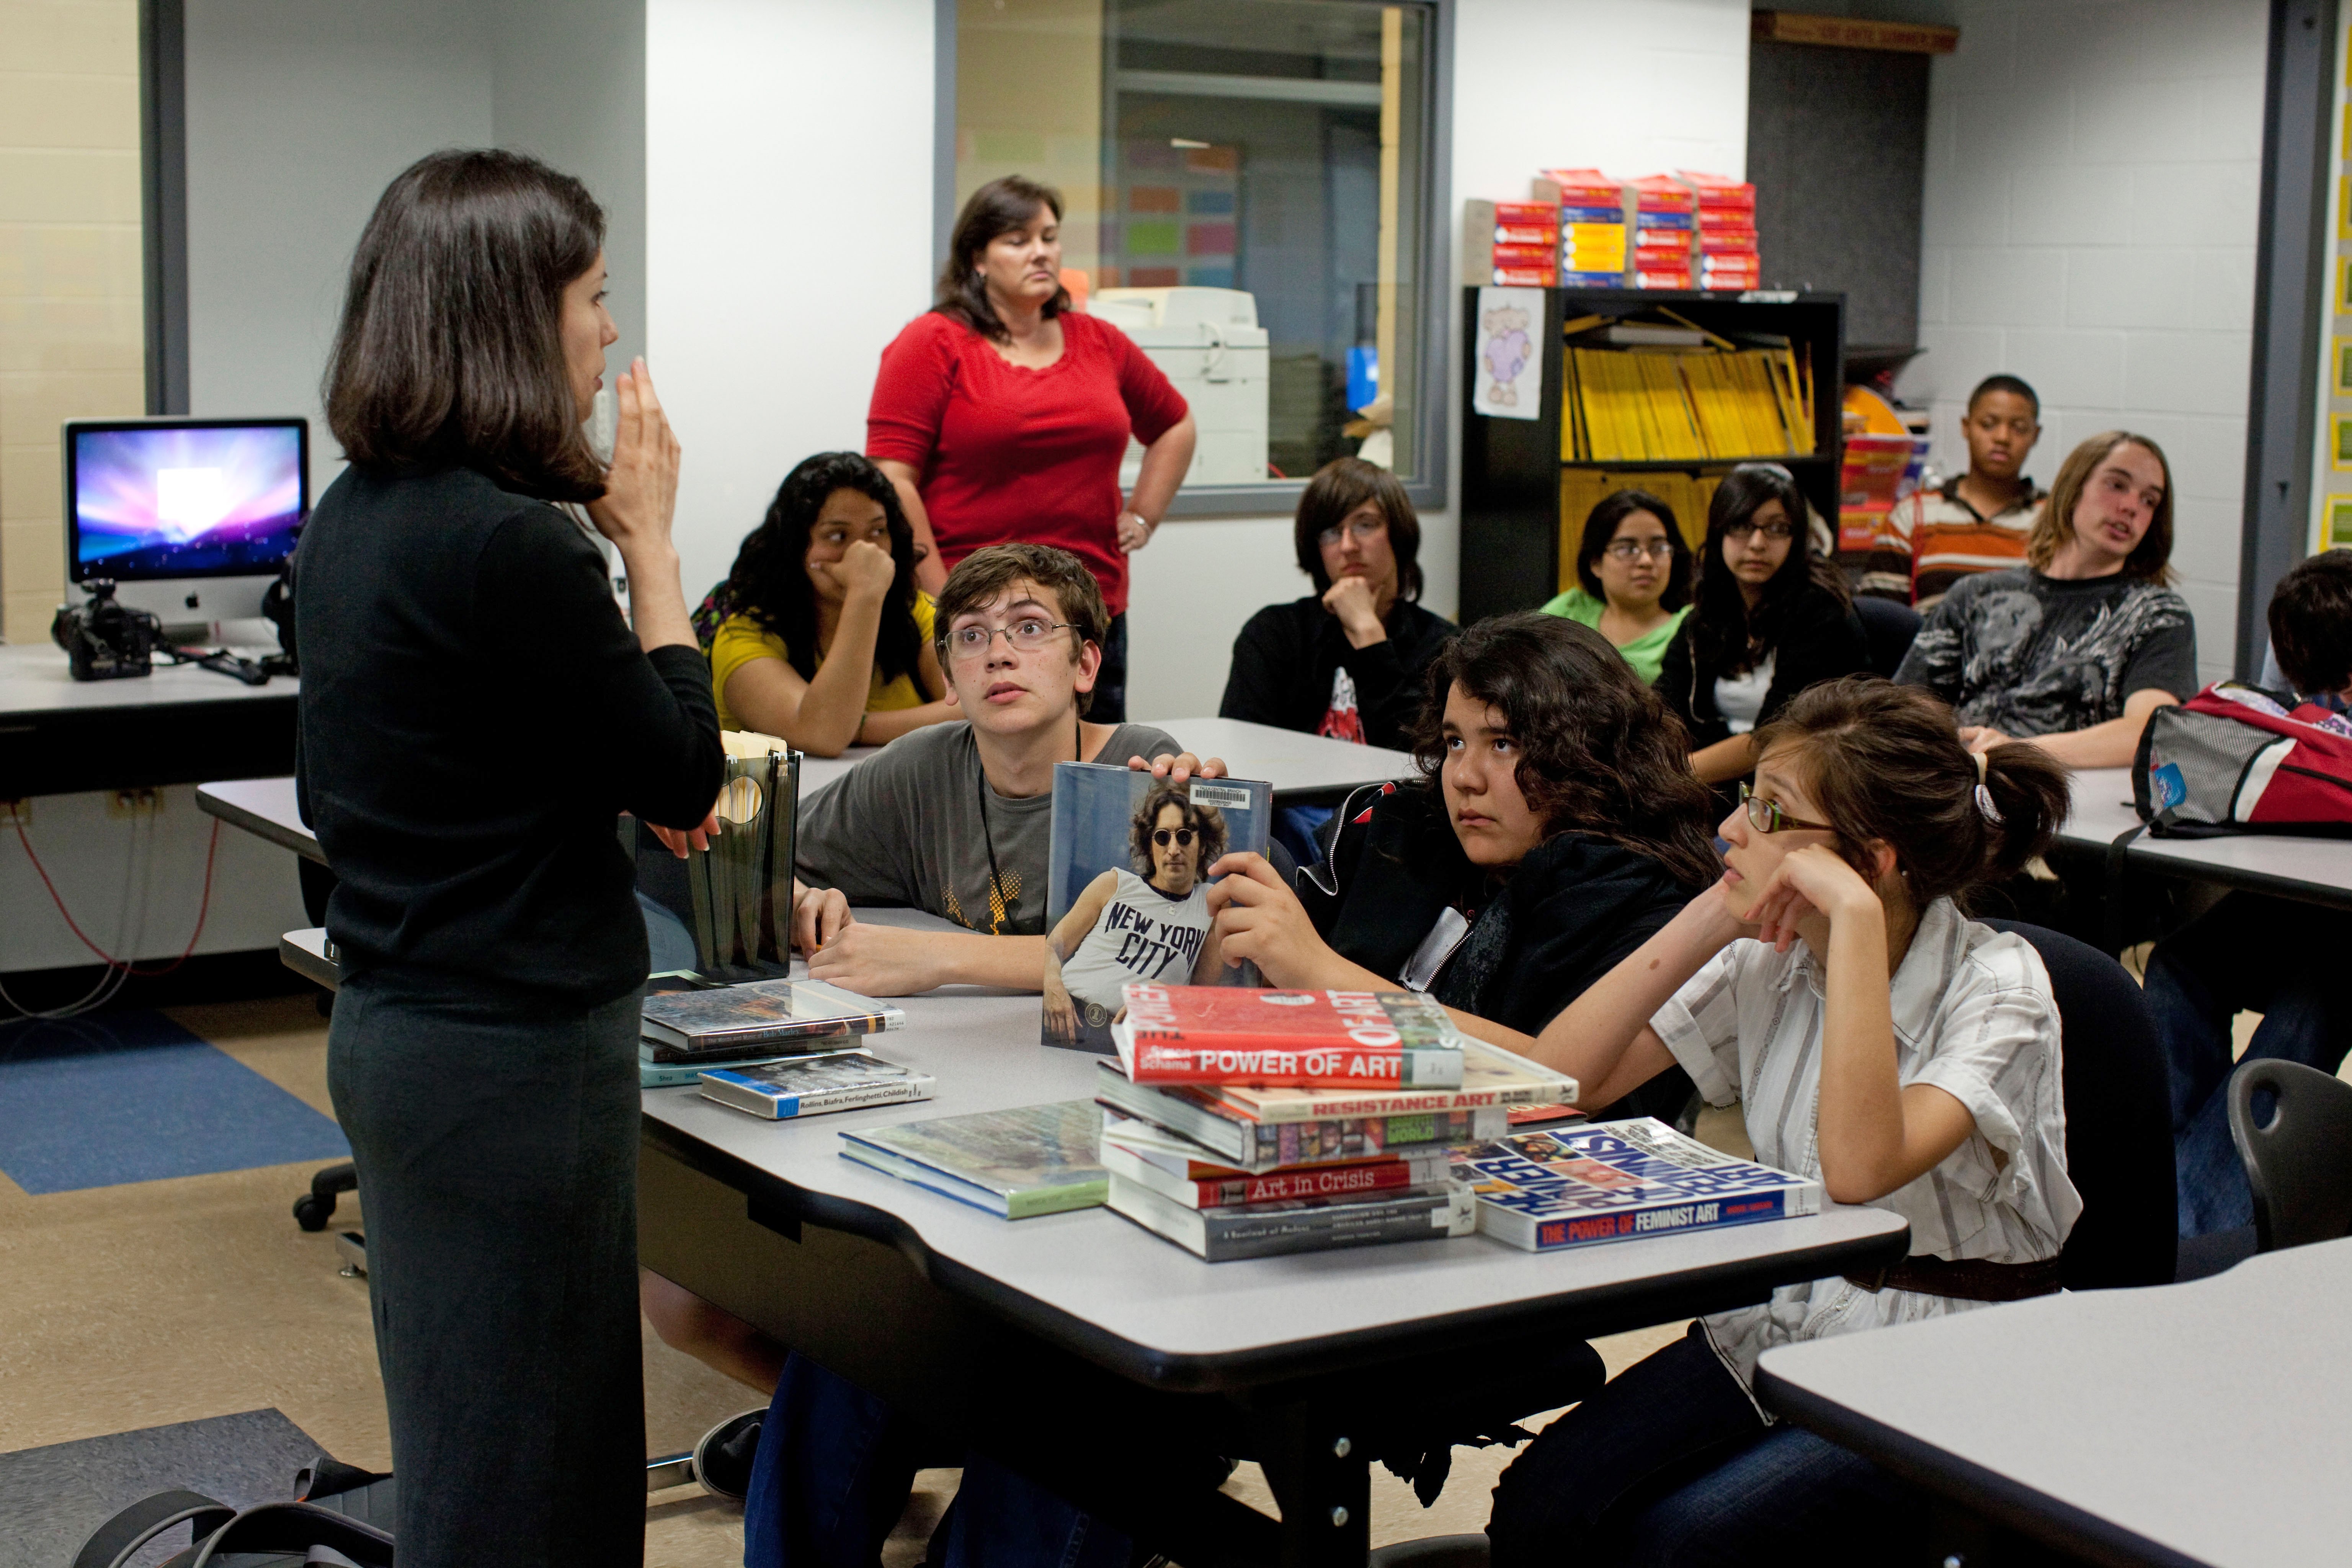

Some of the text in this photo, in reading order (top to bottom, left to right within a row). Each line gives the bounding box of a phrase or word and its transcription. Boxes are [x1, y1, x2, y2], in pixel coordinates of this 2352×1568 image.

[1104, 902, 1205, 973] NEW YORK
[1115, 932, 1178, 979] CITY
[777, 1028, 800, 1037] Marley
[1326, 990, 1402, 1047] OF ART
[1140, 1056, 1191, 1070] Schama
[1200, 1050, 1401, 1078] POWER OF ART
[800, 1100, 823, 1109] Rollins,
[824, 1098, 843, 1106] Biafra,
[844, 1092, 883, 1103] Ferlinghetti,
[883, 1088, 908, 1098] Childish
[1313, 1096, 1449, 1116] RESISTANCE
[1454, 1092, 1497, 1108] ART
[1548, 1130, 1751, 1195] FEMINIST
[1693, 1163, 1806, 1187] ART
[1251, 1168, 1375, 1204] Art in Crisis
[1475, 1158, 1643, 1209] POWER
[1542, 1224, 1567, 1244] THE
[1569, 1218, 1615, 1242] POWER
[1618, 1215, 1635, 1232] OF
[1636, 1206, 1696, 1231] FEMINIST
[1696, 1203, 1720, 1223] ART
